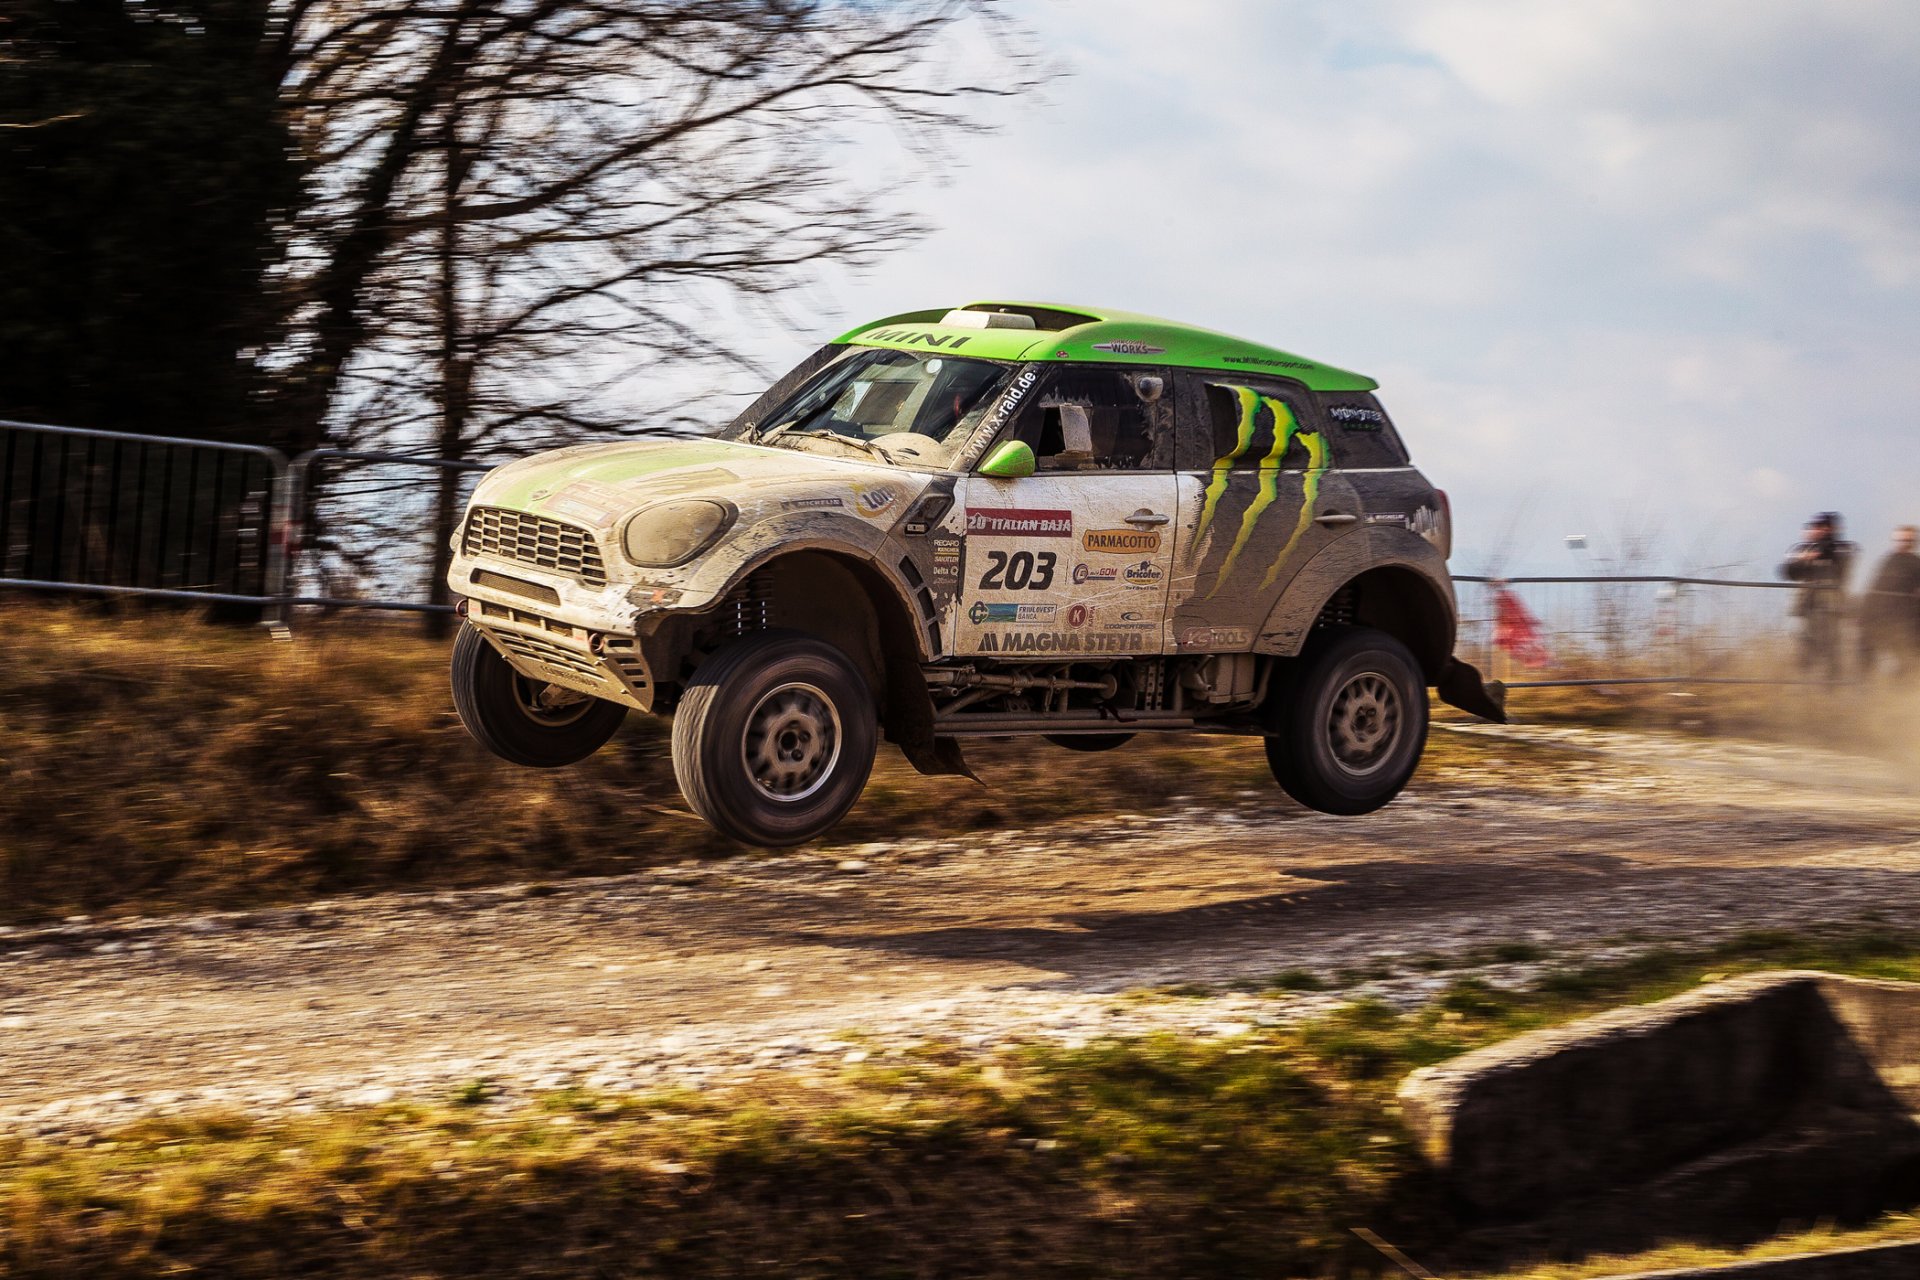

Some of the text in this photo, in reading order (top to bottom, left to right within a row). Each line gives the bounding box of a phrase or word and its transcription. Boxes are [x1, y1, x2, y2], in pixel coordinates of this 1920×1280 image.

[866, 329, 972, 348] MINI
[1112, 343, 1148, 354] WORKS
[965, 370, 1037, 461] www.x-raid.de
[992, 518, 1038, 531] ITALIAN
[1040, 520, 1071, 532] BAJA
[1088, 534, 1156, 549] PARMACOTTO
[933, 566, 949, 575] Delta
[979, 551, 1057, 590] 203
[1126, 568, 1160, 579] Bricofer
[1002, 632, 1144, 652] MAGNA STEYR
